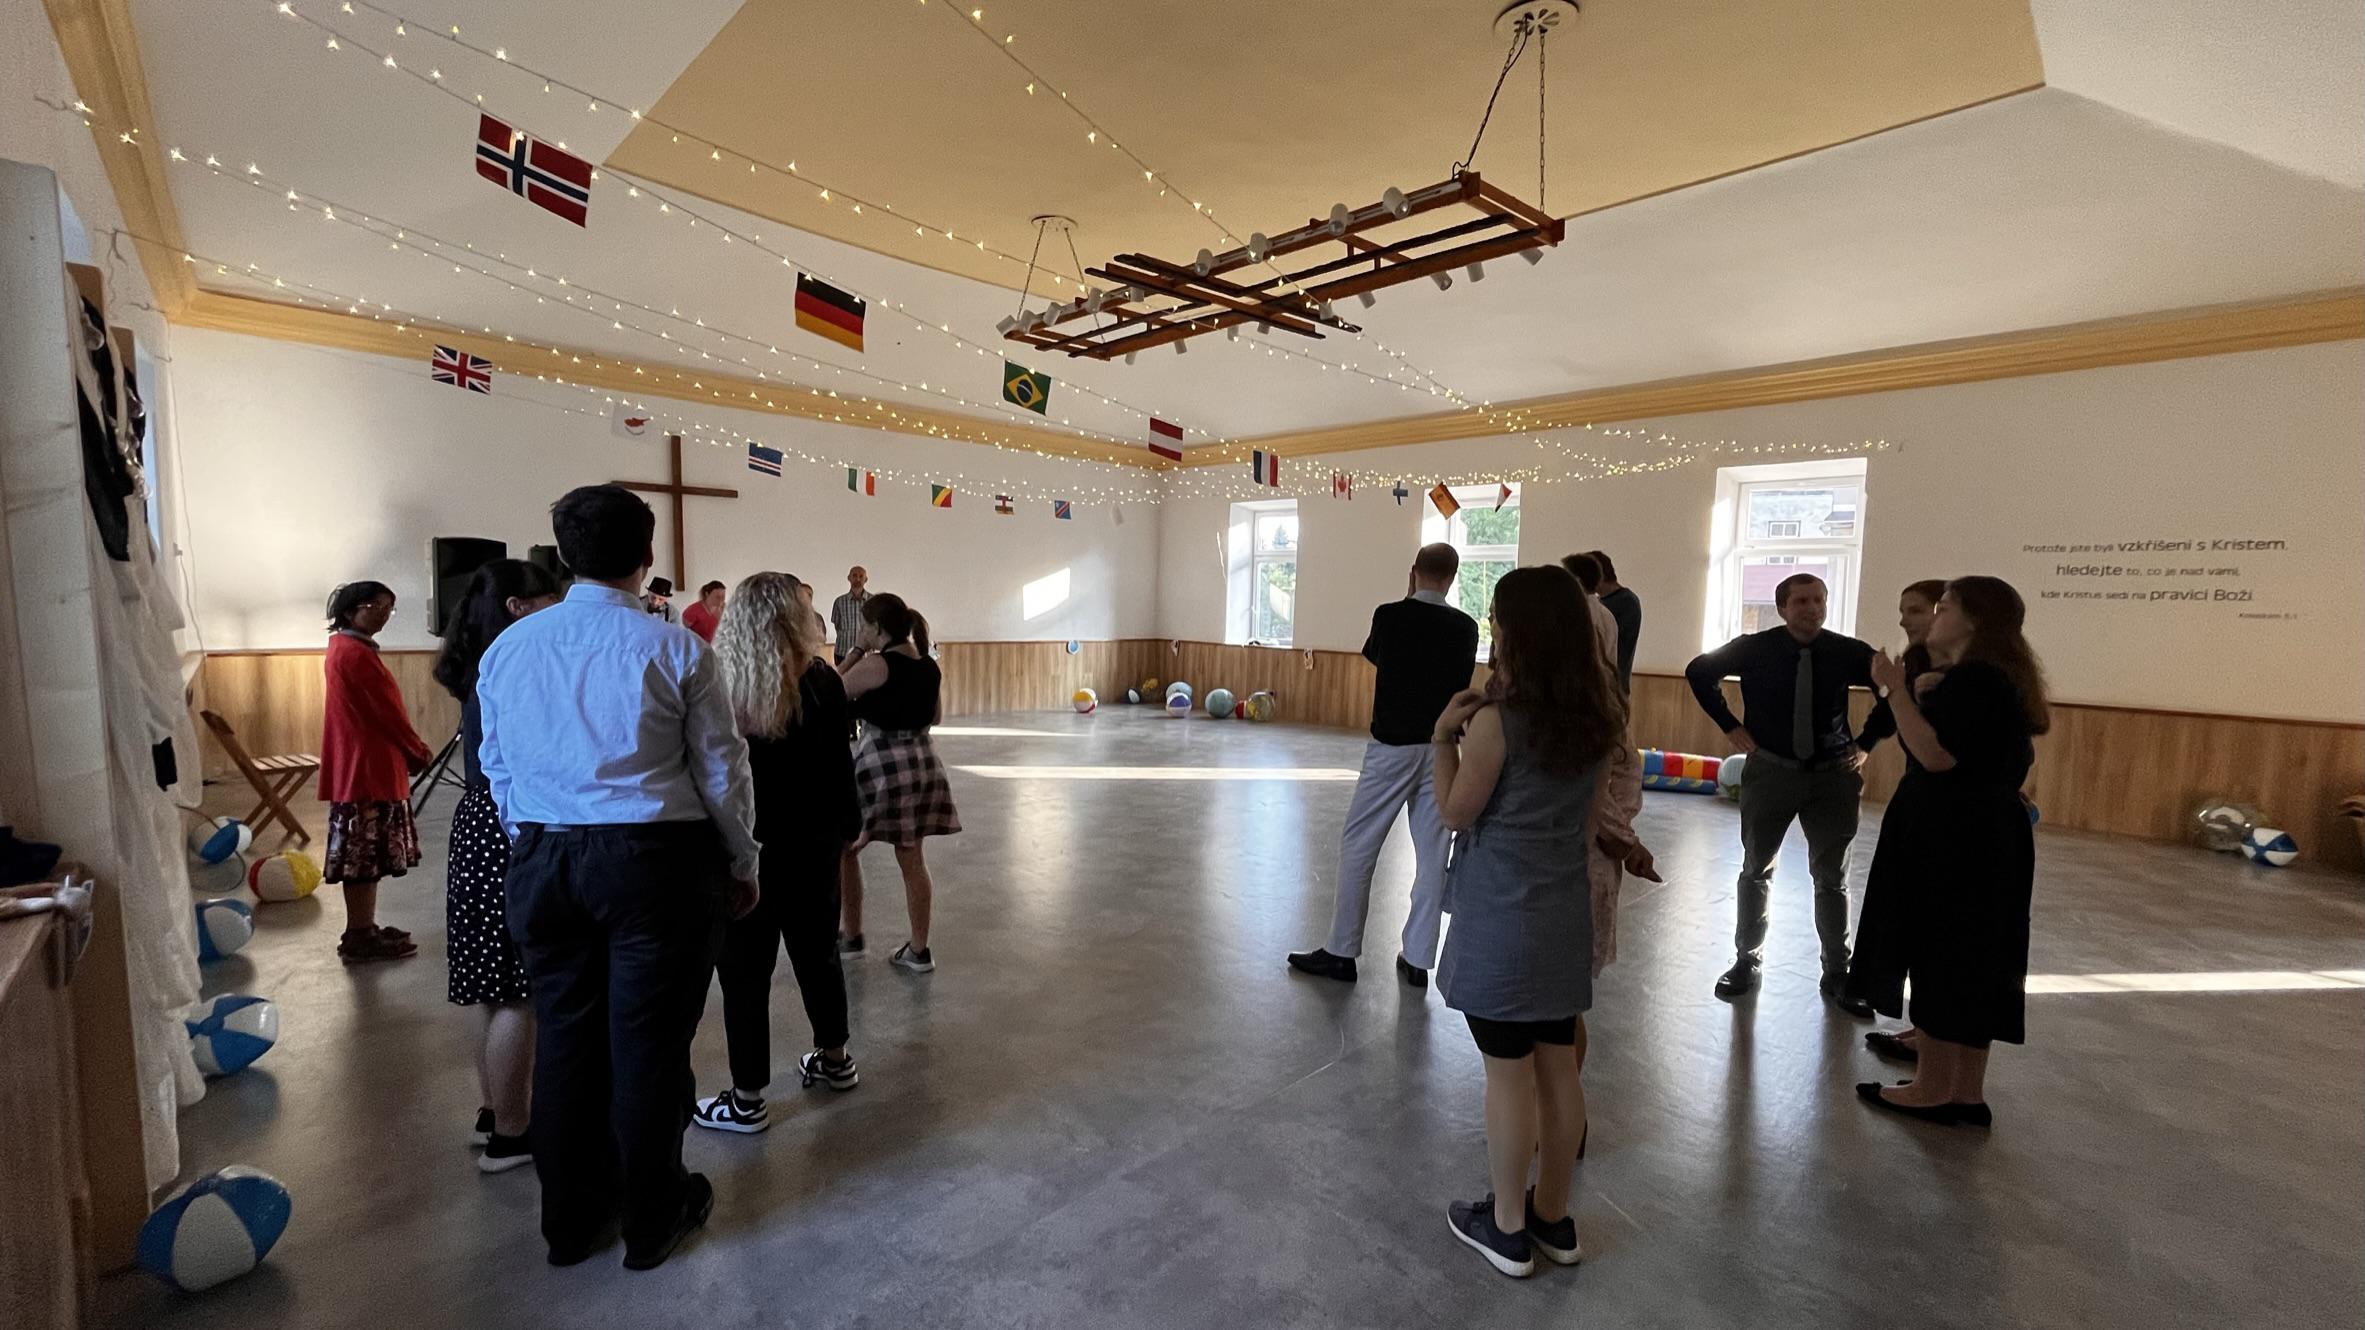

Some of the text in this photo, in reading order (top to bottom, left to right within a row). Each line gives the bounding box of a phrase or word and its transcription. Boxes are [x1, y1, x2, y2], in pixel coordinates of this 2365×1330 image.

[2196, 541, 2207, 551] s
[2056, 564, 2122, 577] hledejte
[2146, 568, 2162, 576] co
[2180, 567, 2204, 576] nad
[2149, 588, 2208, 602] pravici
